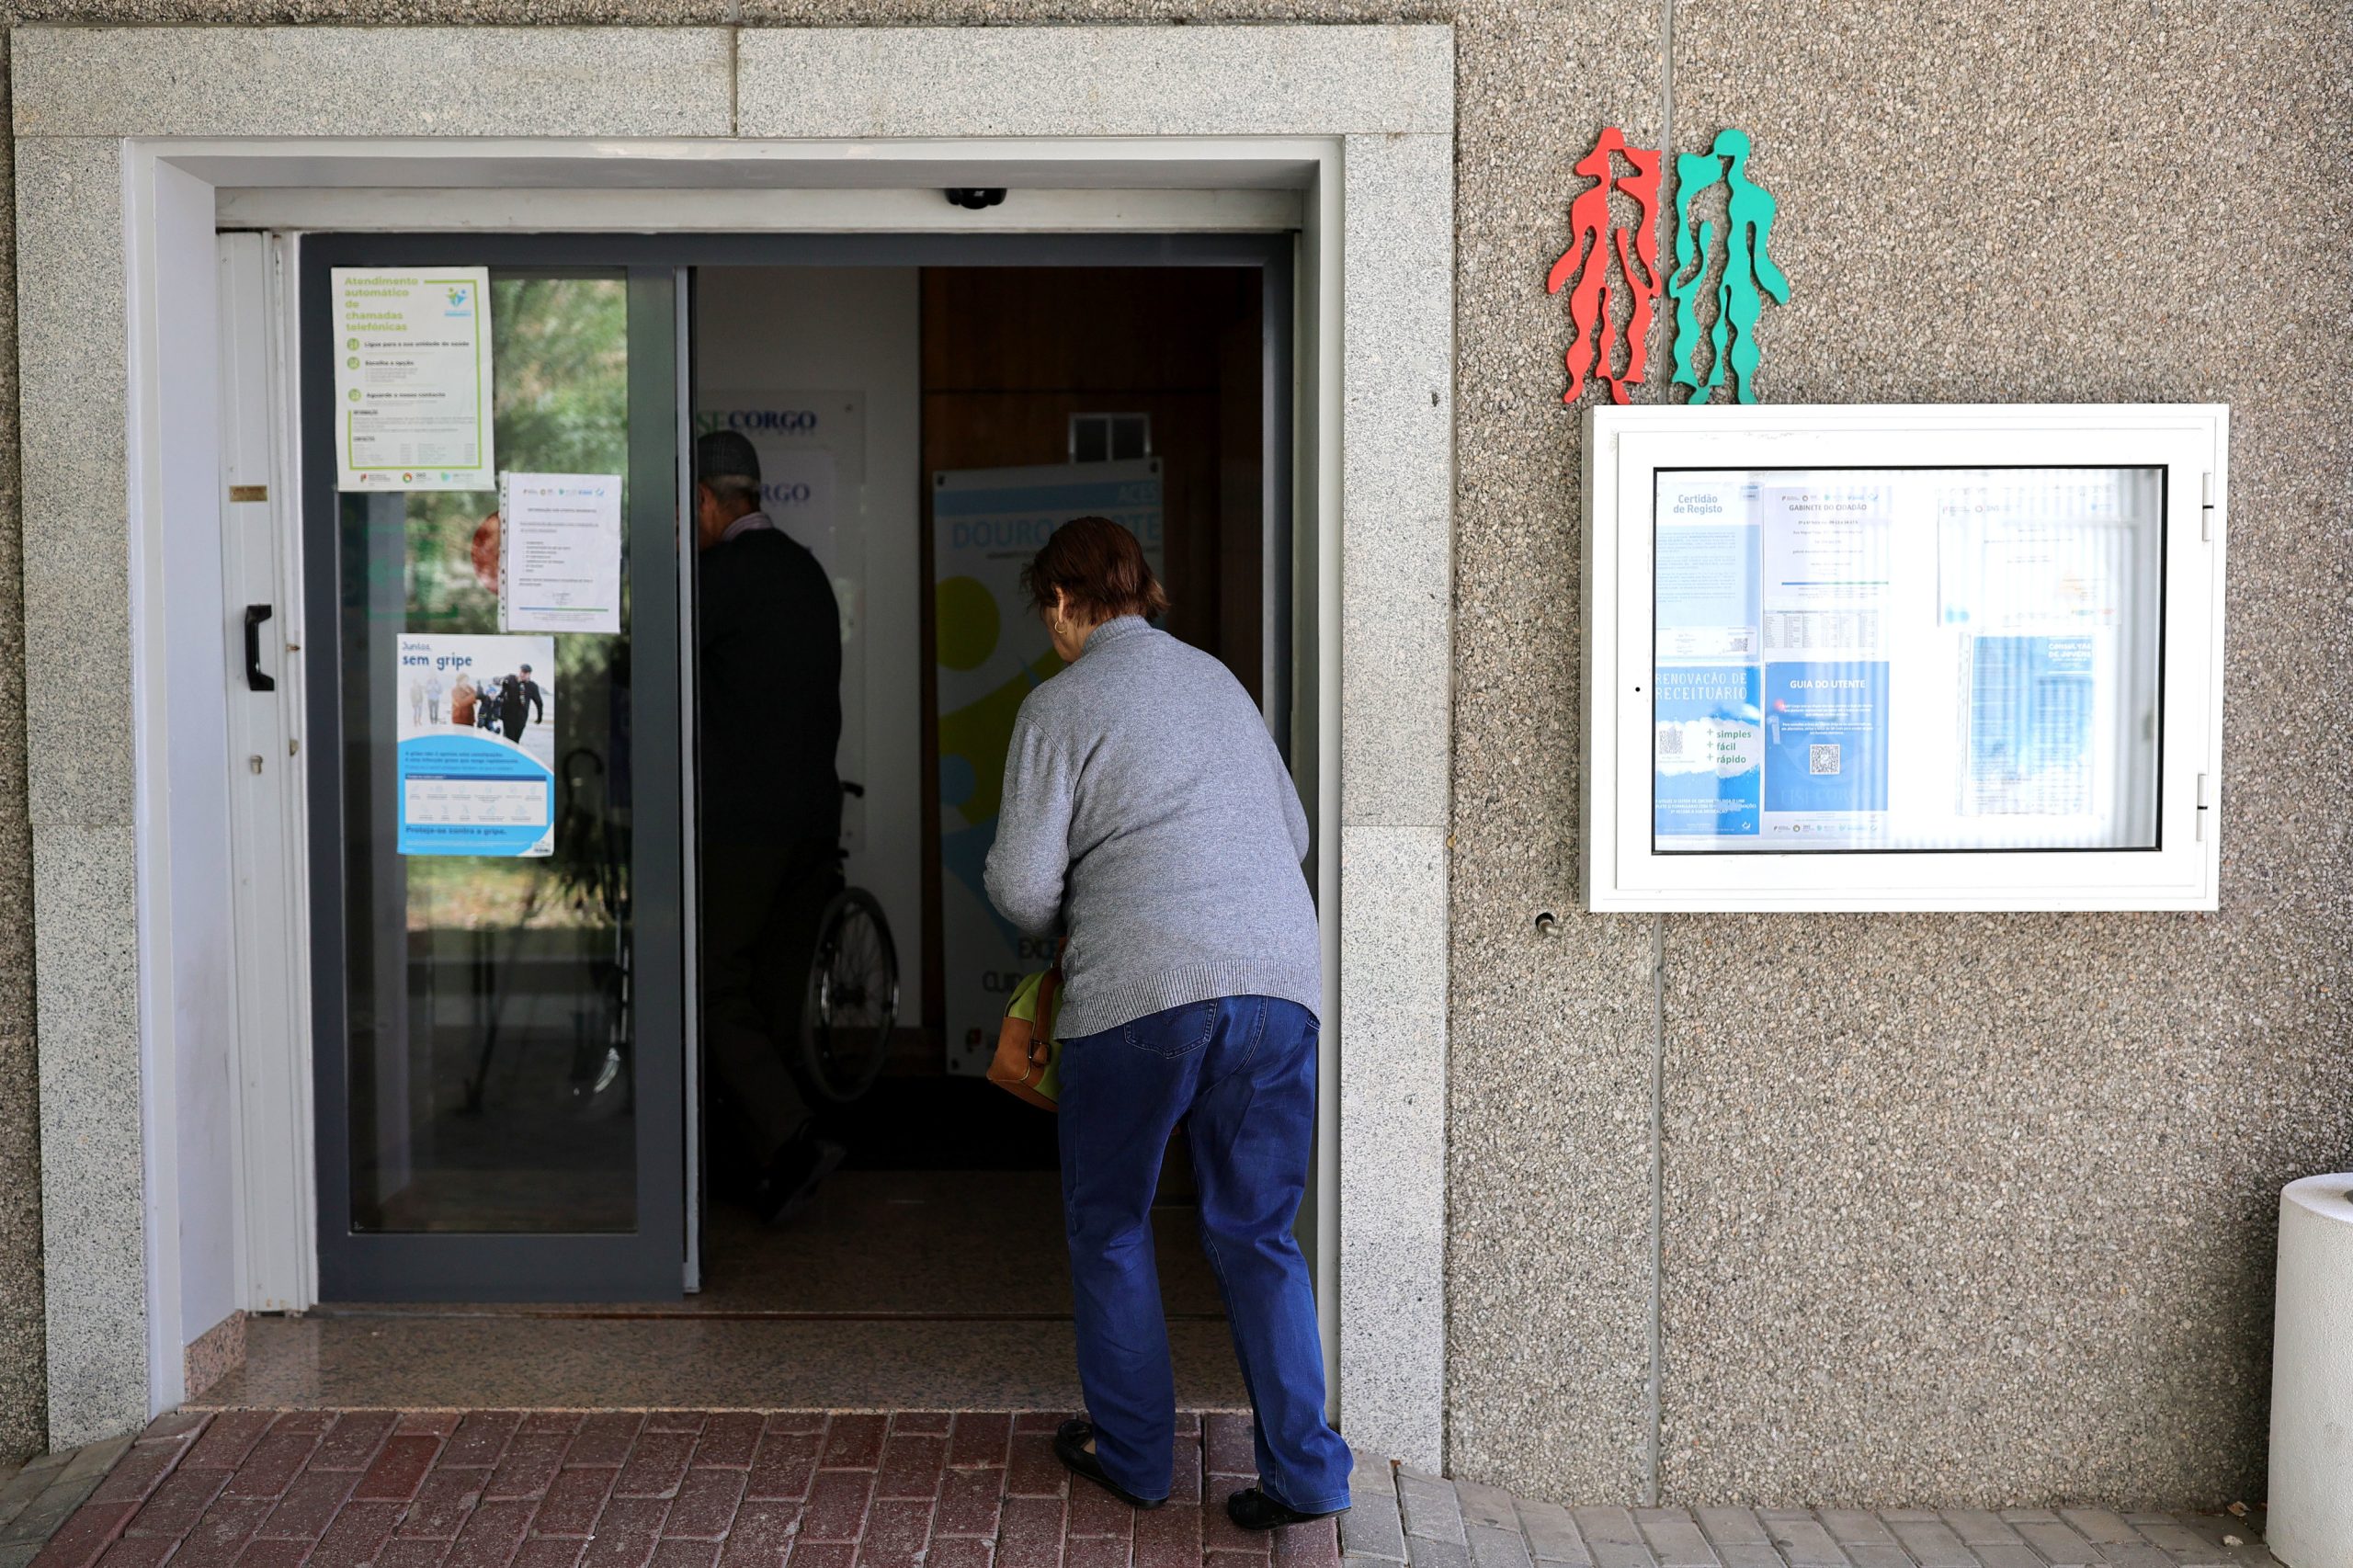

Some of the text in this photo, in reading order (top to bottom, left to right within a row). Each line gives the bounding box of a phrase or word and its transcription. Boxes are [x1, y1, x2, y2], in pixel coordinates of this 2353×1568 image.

[345, 276, 418, 286] Atendimento
[345, 287, 409, 297] automático
[346, 300, 359, 309] de
[346, 311, 403, 320] chamadas
[729, 410, 817, 428] CORGO
[760, 483, 811, 502] RGO
[1678, 494, 1718, 504] Certidão
[1674, 505, 1722, 515] de Registo
[952, 517, 1054, 549] DOURO
[403, 652, 472, 671] sem gripe
[1732, 673, 1746, 685] DE
[1790, 679, 1866, 688] GUIA DO UTENTE
[1717, 730, 1751, 739] simples
[1717, 742, 1736, 751] fácil
[1717, 756, 1746, 765] rápido
